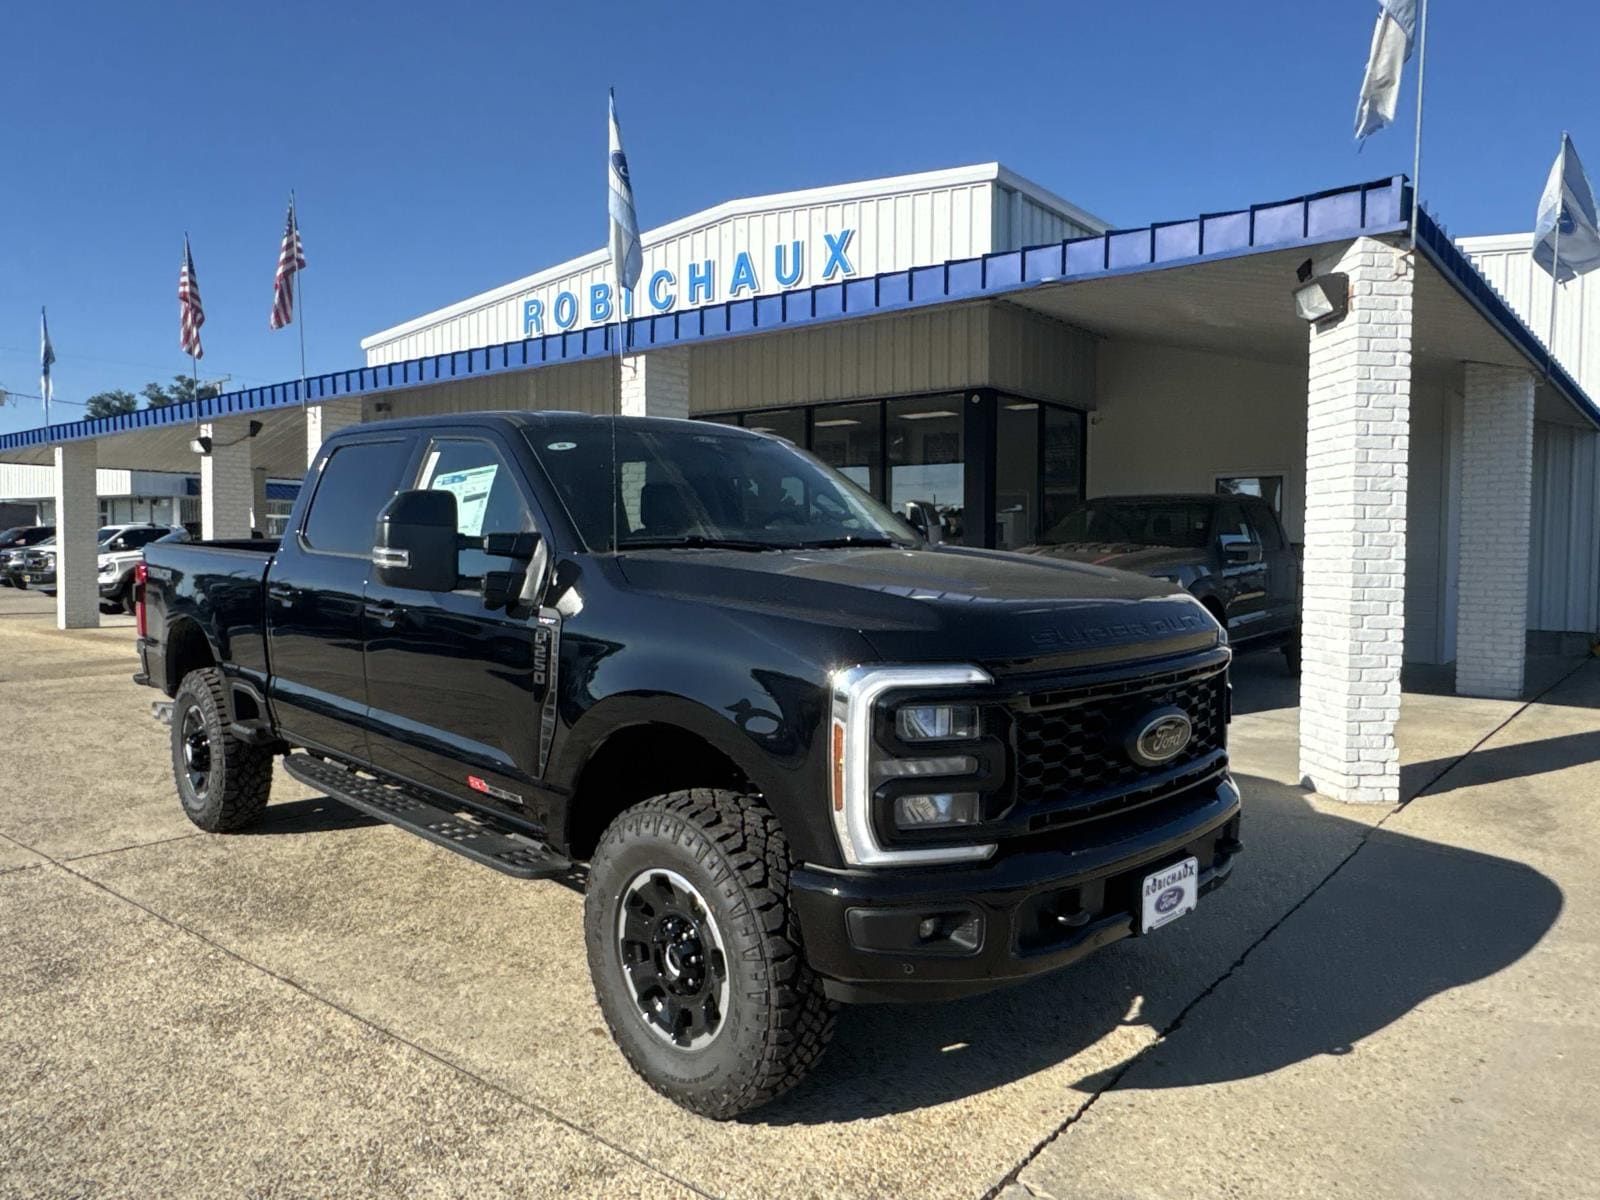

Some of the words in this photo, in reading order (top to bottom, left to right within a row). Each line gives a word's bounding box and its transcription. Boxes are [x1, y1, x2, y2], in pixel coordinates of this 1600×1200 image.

[523, 229, 855, 336] ROBICHAUX
[1153, 724, 1182, 751] Ford
[1145, 864, 1195, 897] ROBICHAUX
